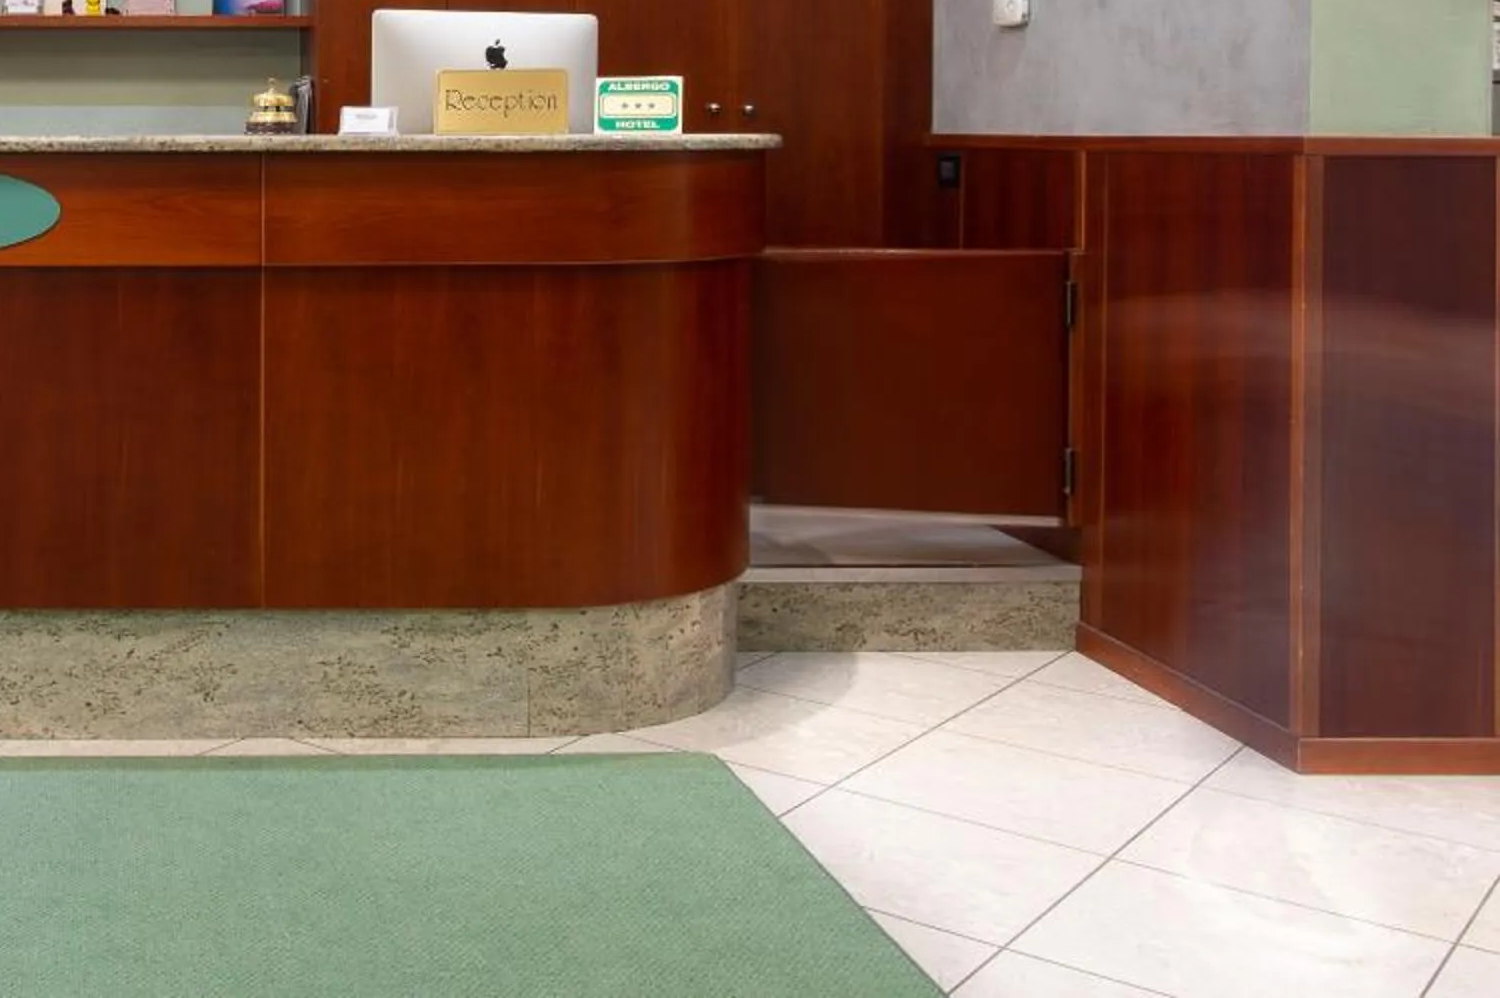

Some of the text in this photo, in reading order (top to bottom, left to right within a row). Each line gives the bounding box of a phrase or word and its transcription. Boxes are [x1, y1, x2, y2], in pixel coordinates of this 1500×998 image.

[607, 81, 670, 91] ALBERGO
[445, 89, 558, 118] Reception
[615, 121, 660, 129] HOTEL
